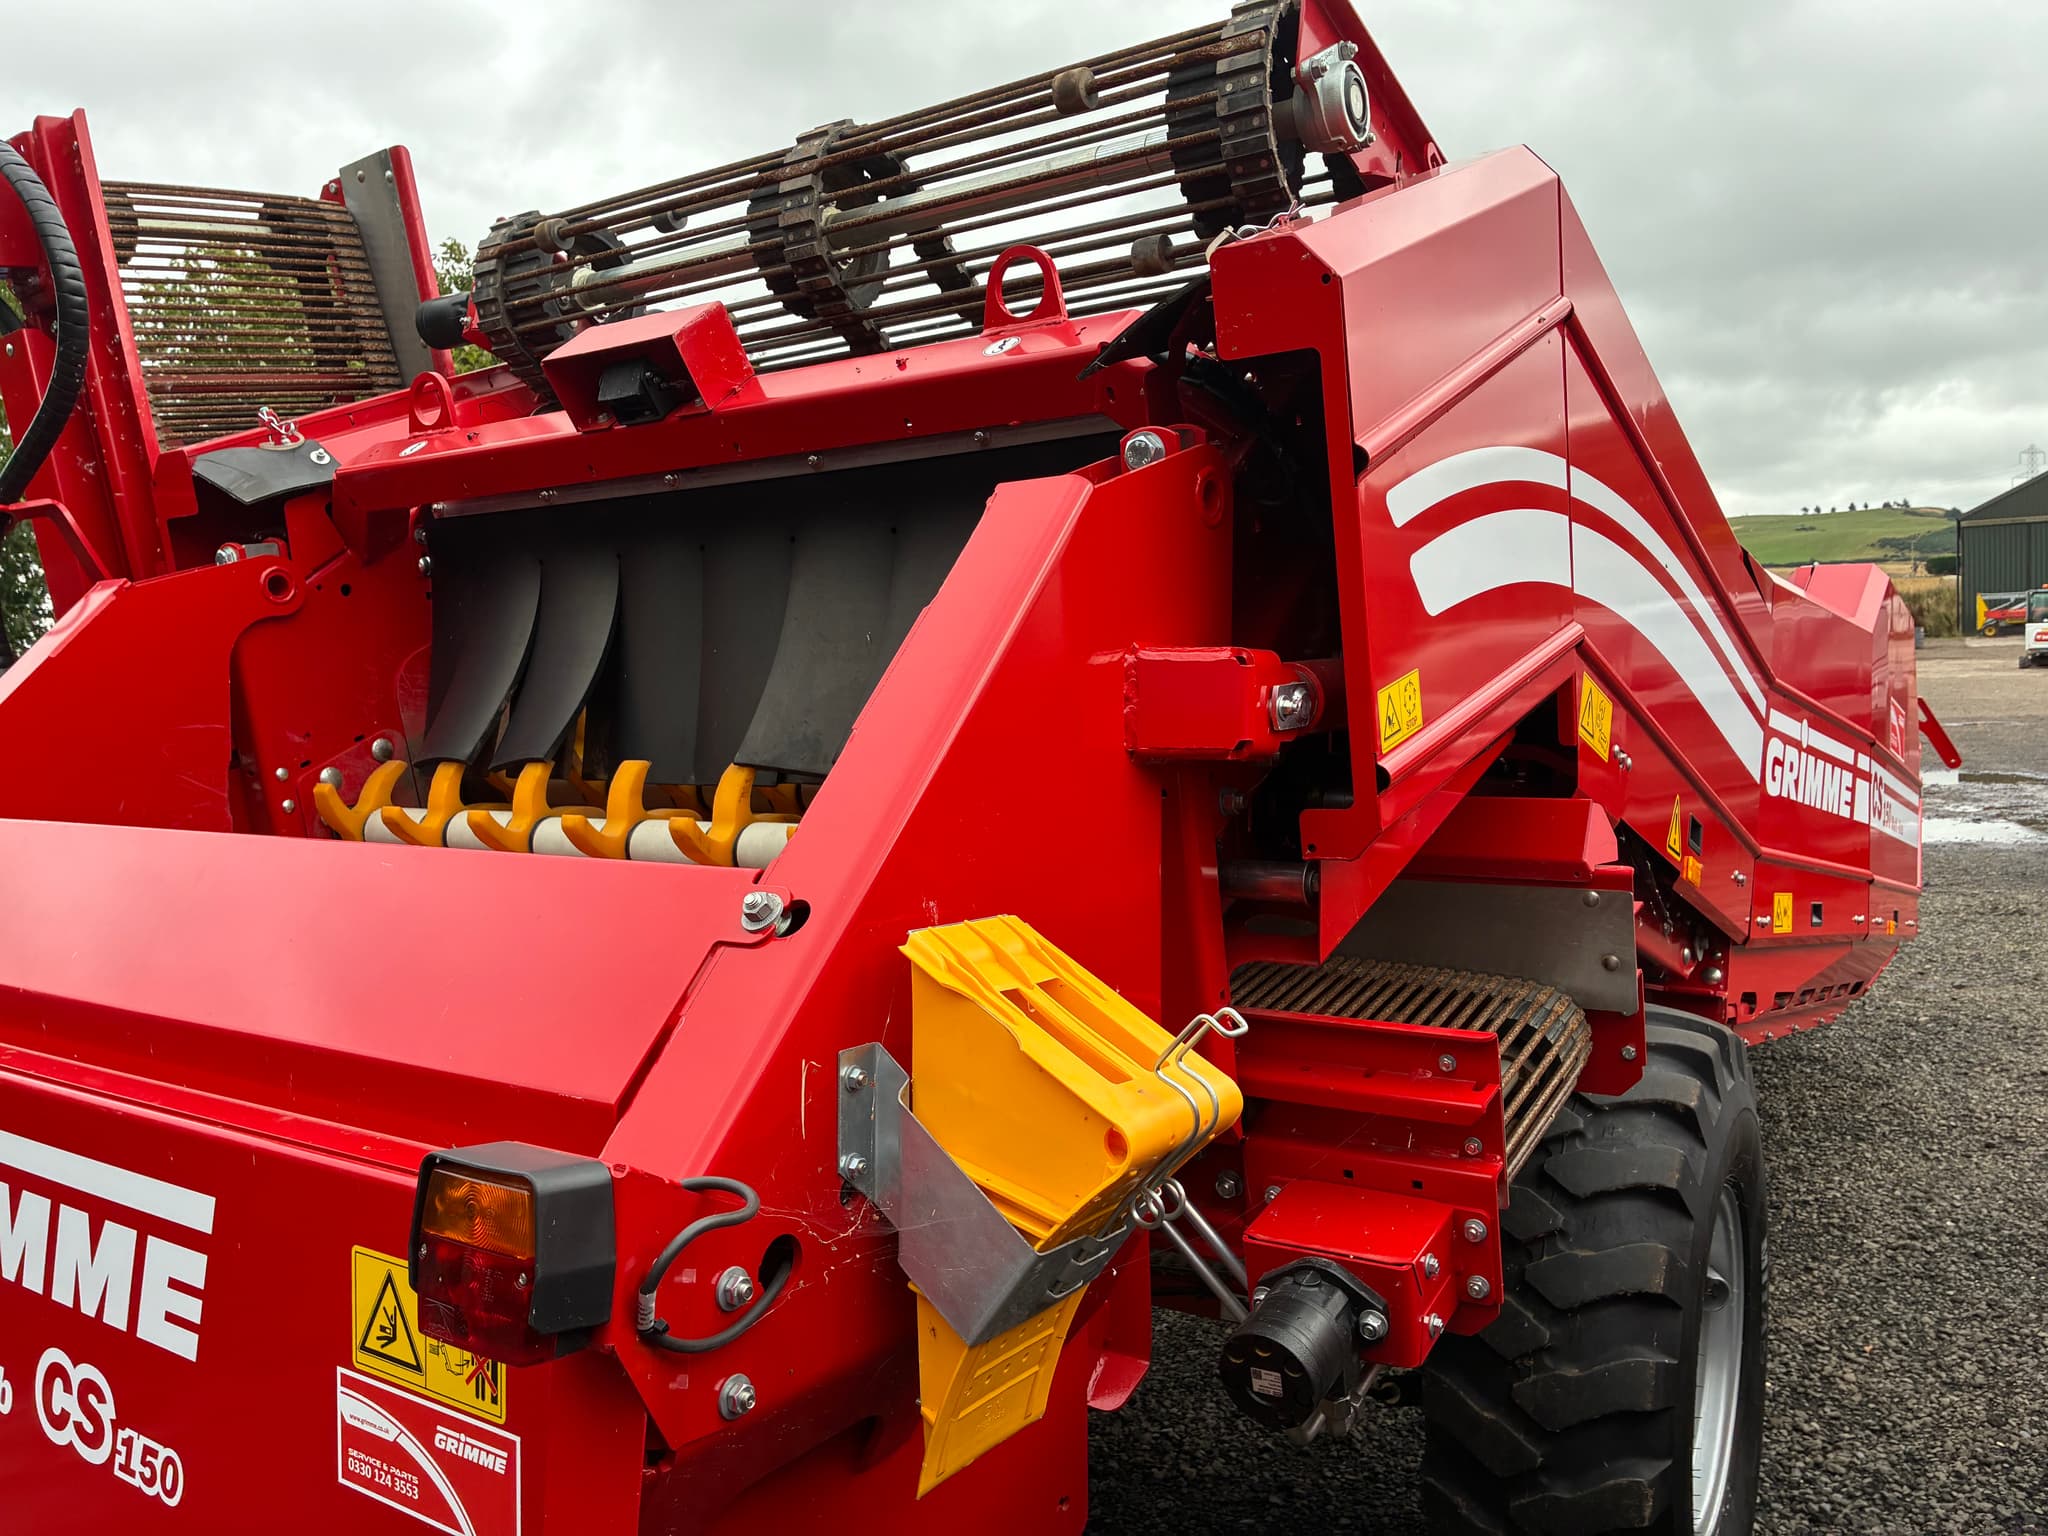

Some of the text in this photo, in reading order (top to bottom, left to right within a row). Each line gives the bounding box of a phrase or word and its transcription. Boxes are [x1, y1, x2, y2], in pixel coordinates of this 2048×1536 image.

[35, 1347, 184, 1507] CS 150
[348, 1413, 390, 1435] www.grimme.co.uk
[347, 1447, 419, 1485] SERVICE & PARTS
[347, 1457, 419, 1500] 0330 124 3553
